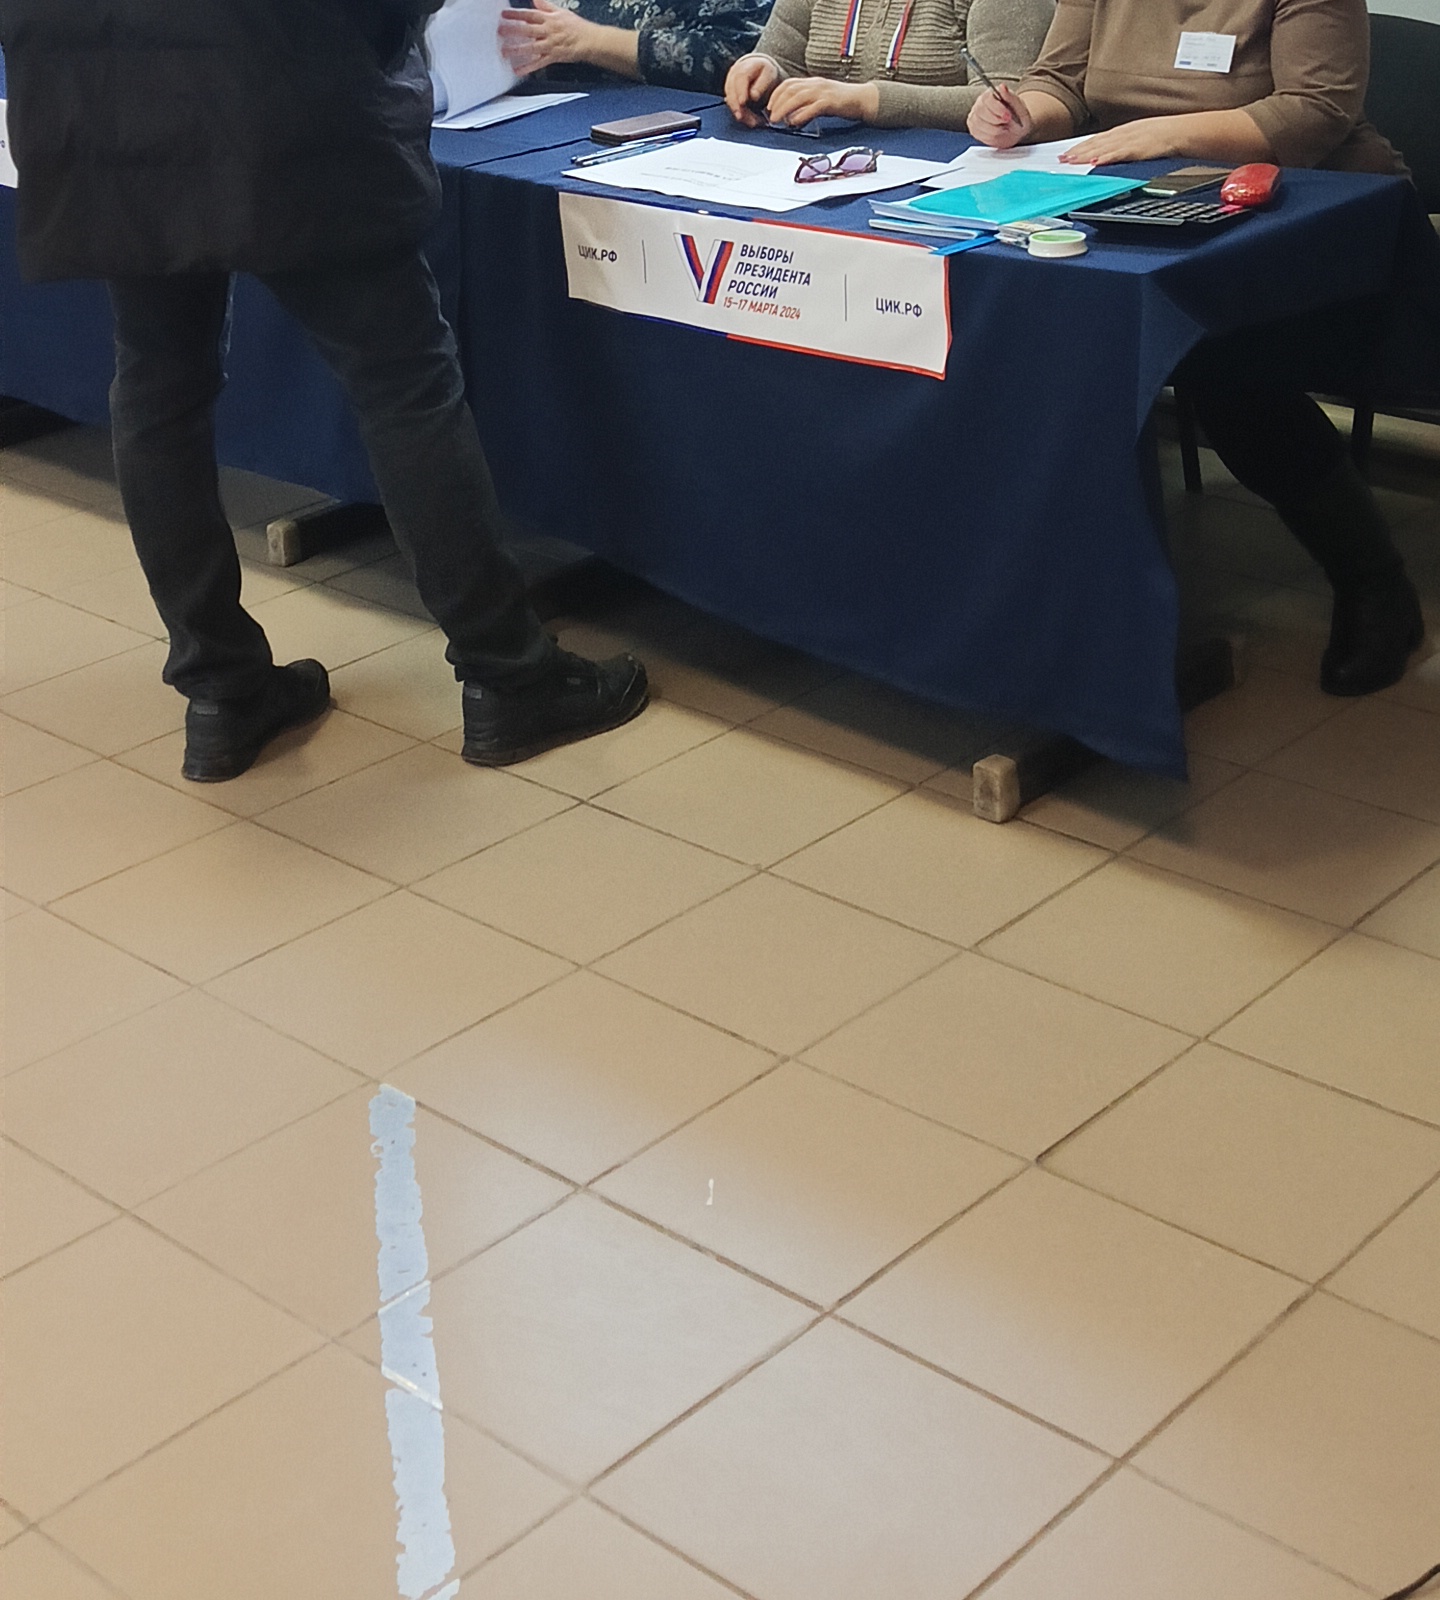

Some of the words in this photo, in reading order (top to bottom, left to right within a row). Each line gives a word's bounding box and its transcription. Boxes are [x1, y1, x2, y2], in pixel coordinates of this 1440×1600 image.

[578, 244, 618, 264] ЦИК.РФ
[740, 243, 794, 265] ВЫБОРЫ
[734, 261, 812, 286] ПРЕЗИДЕНТА
[727, 279, 778, 300] РОССИИ
[749, 299, 779, 316] МАРТА
[779, 305, 802, 321] 2024
[875, 296, 923, 319] ЦИК.РФ
